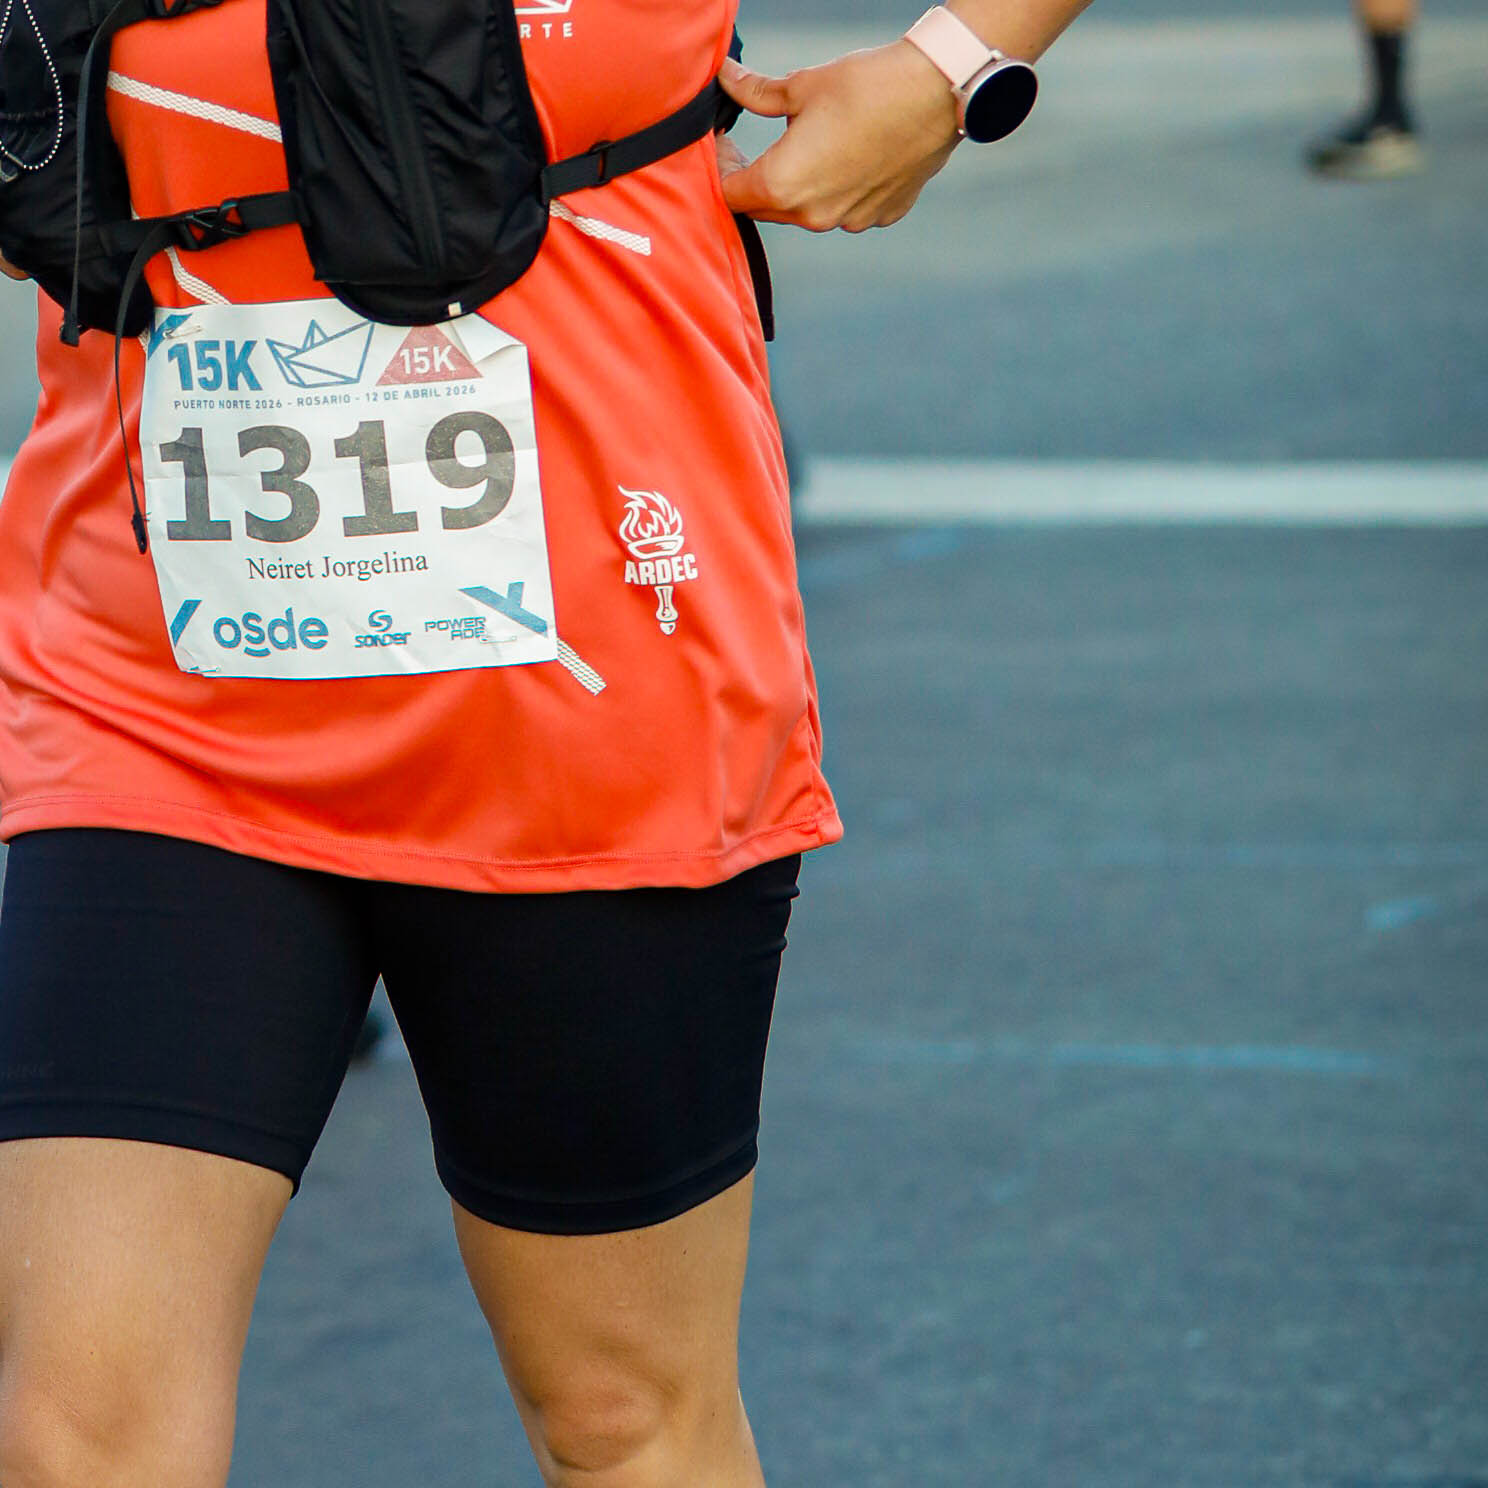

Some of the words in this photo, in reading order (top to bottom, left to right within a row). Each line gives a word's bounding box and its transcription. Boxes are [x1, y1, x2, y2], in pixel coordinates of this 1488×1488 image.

[519, 21, 574, 39] RTE
[167, 339, 264, 392] 15K
[399, 343, 457, 376] 15K
[174, 399, 215, 410] PUERTO
[218, 399, 252, 410] NORTE
[255, 398, 282, 409] 2026
[297, 393, 351, 407] ROSARIO
[365, 391, 379, 403] 12
[383, 390, 400, 401] DE
[404, 387, 441, 399] ABRIL
[445, 384, 477, 397] 2026
[158, 410, 516, 544] 1319
[245, 555, 315, 581] Neiret
[322, 551, 429, 580] Jorgelina
[624, 553, 699, 586] ARDEC
[212, 607, 329, 653] osde
[424, 616, 486, 632] POWER
